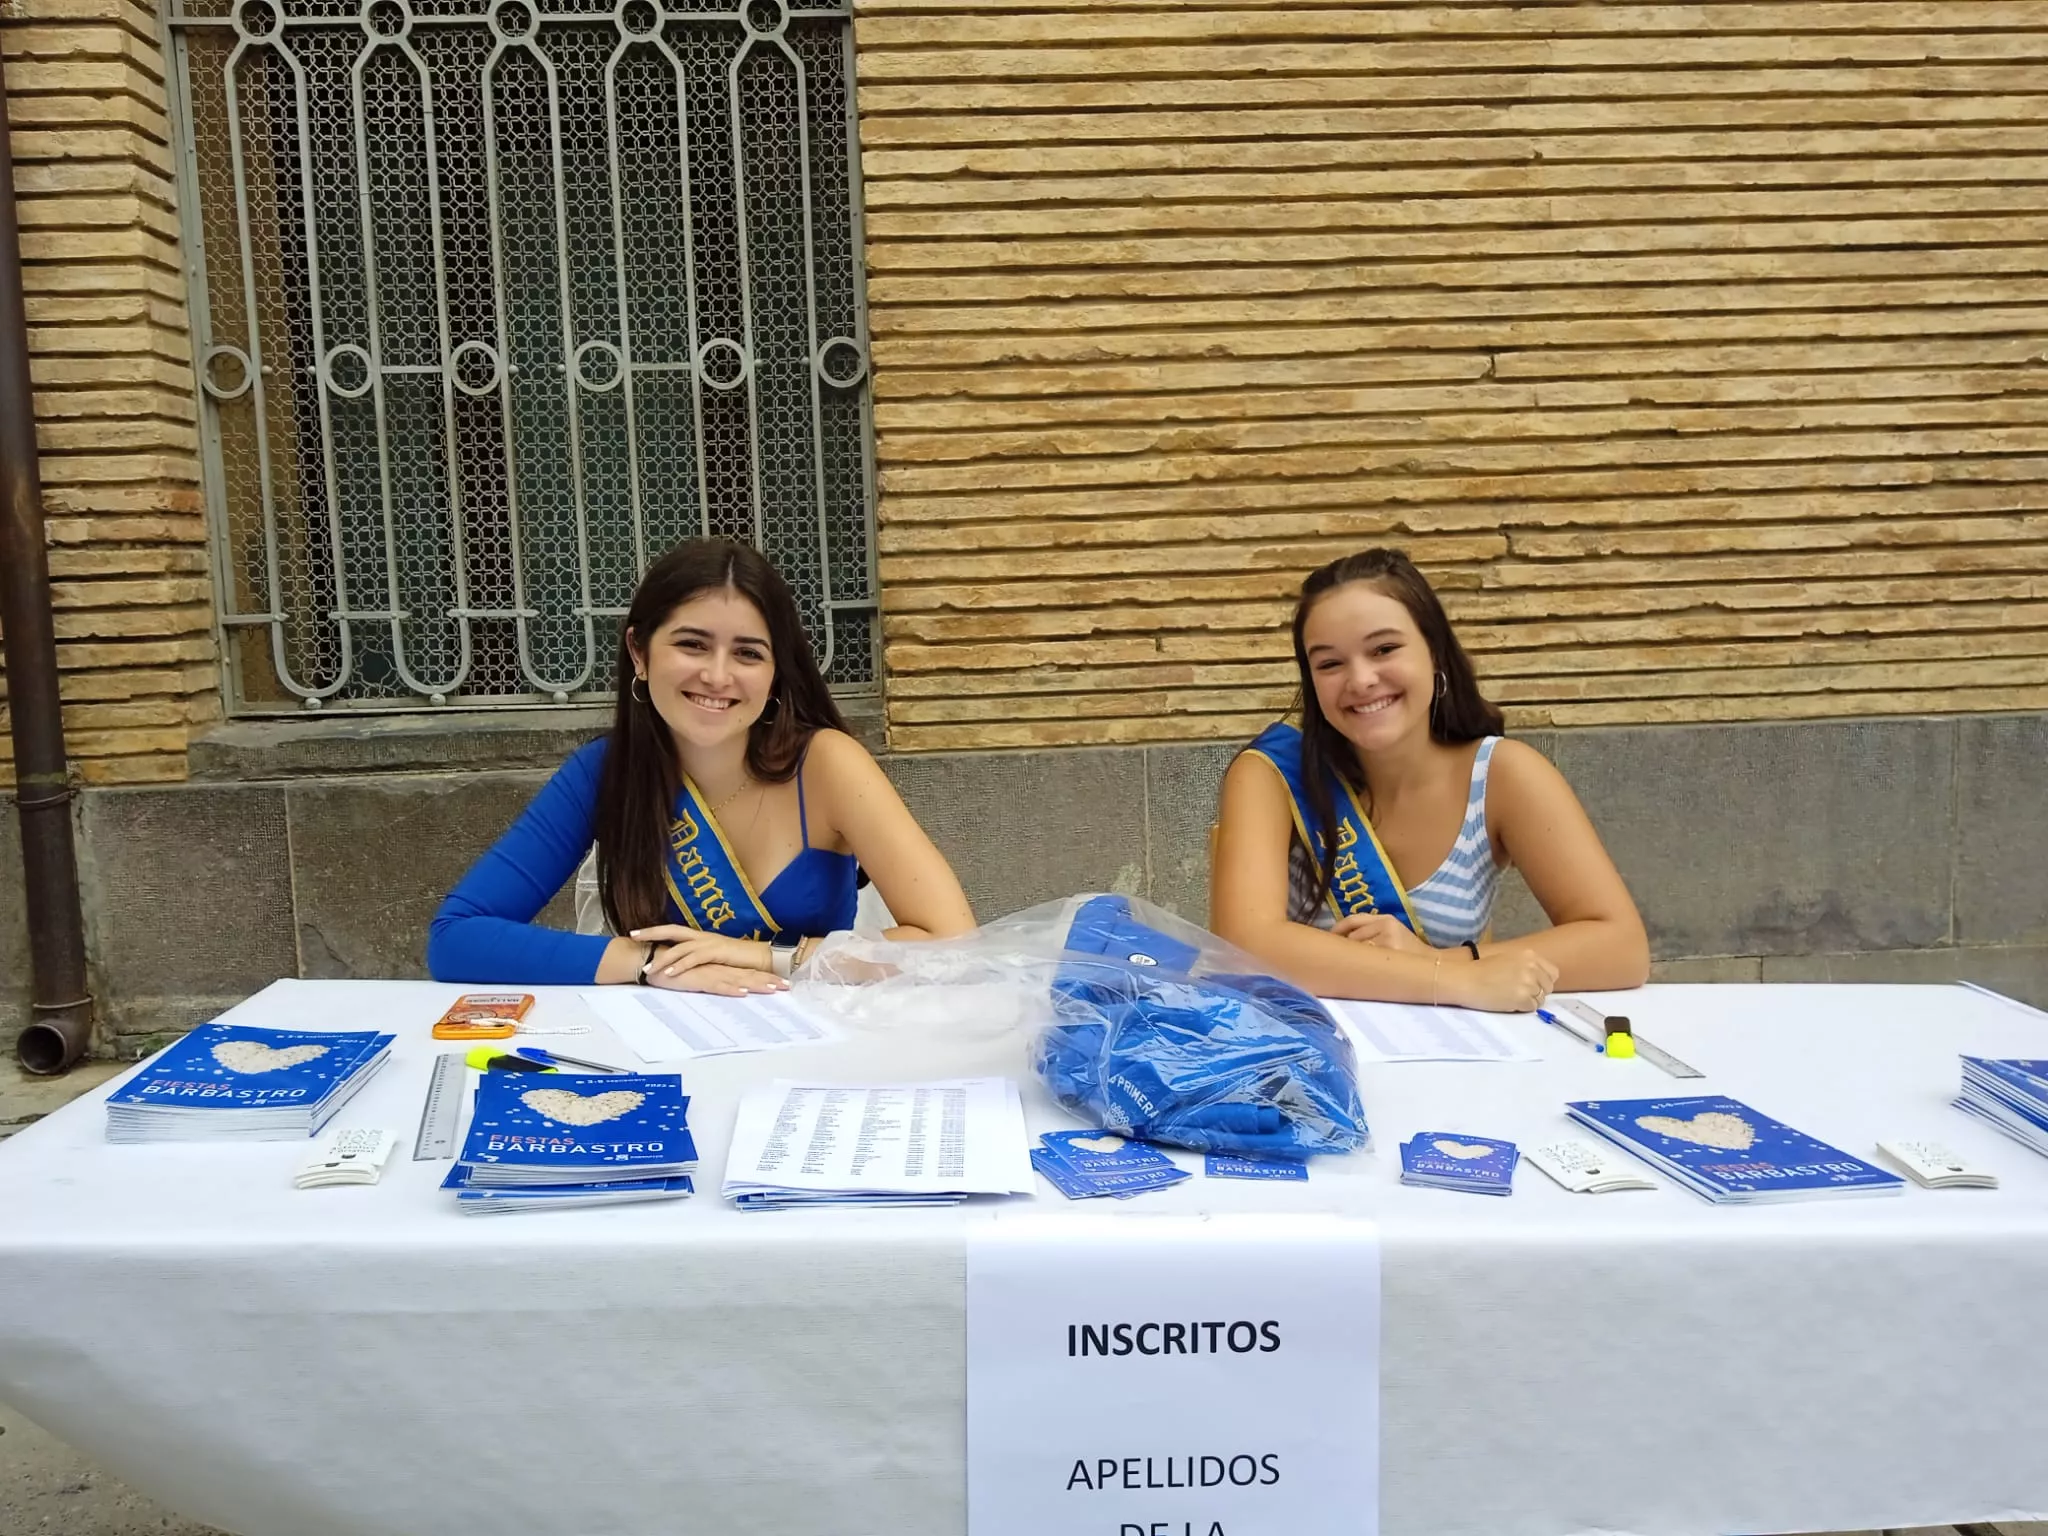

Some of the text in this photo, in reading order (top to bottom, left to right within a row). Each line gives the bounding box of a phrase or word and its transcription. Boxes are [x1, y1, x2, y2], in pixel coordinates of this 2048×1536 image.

[151, 1079, 231, 1090] FIESTAS
[142, 1086, 307, 1099] BARBASTRO
[490, 1134, 575, 1145] FIESTAS
[487, 1142, 664, 1154] BARBASTRO
[1082, 1156, 1160, 1169] BARBASTRO
[1216, 1166, 1297, 1175] BARBASTRO
[1416, 1163, 1500, 1178] BARBASTRO
[1712, 1162, 1864, 1180] BARBASTRO
[1068, 1320, 1281, 1356] INSCRITOS
[1066, 1453, 1280, 1490] APELLIDOS
